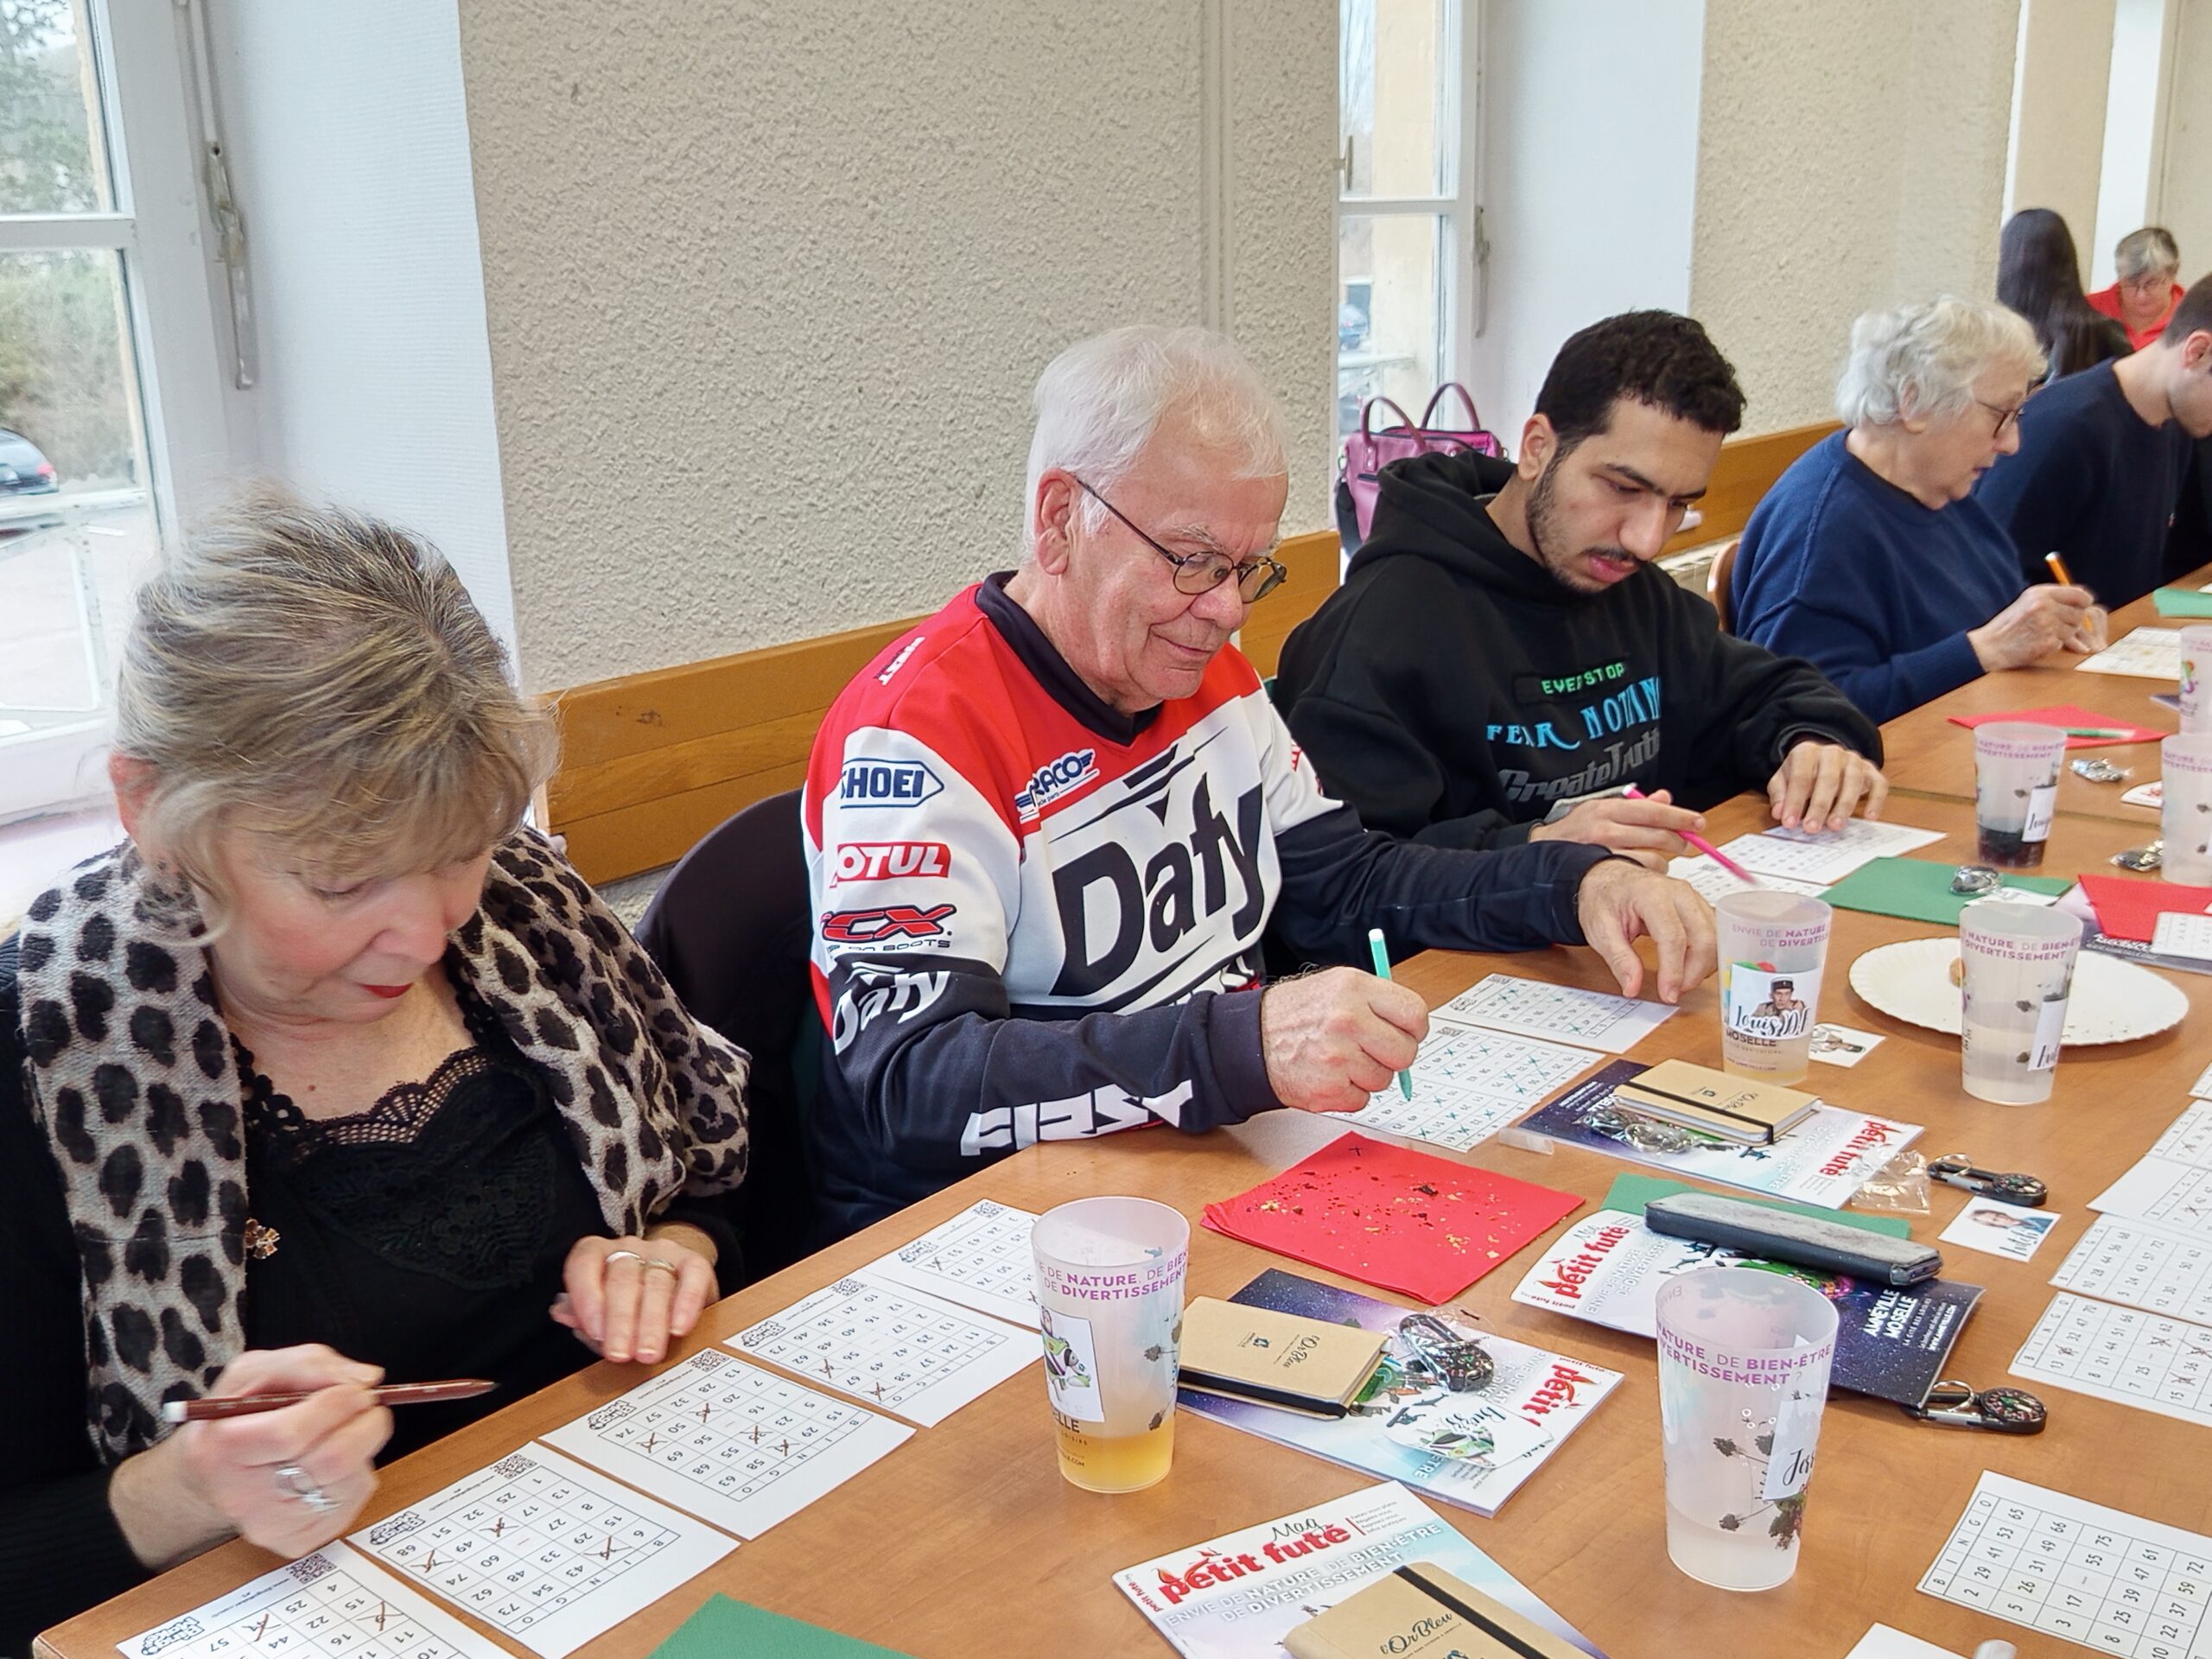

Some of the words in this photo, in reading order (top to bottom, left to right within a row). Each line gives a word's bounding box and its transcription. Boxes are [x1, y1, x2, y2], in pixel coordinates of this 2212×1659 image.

[1049, 771, 1264, 996] Dafy
[1732, 923, 1762, 937] ENVIE
[1766, 929, 1782, 938] DE
[1785, 923, 1826, 938] NATURE
[1760, 938, 1774, 948] DE
[1967, 931, 2014, 950] NATURE
[2022, 941, 2037, 950] DE
[1554, 1254, 1603, 1299] petit
[1585, 1224, 1630, 1254] futé
[1047, 1267, 1063, 1281] DE
[1147, 1265, 1163, 1280] DE
[1044, 1277, 1058, 1293] DE
[1061, 1265, 1186, 1300] DIVERTISSEMENT
[1586, 1286, 1611, 1314] ENVIE
[1613, 1249, 1641, 1283] NATURE
[1616, 1283, 1629, 1297] DE
[1862, 1288, 1900, 1338] AMNÉVILLE
[1883, 1295, 1918, 1339] MOSELLE
[1661, 1340, 1791, 1385] VERTISSEMENT
[1717, 1353, 1740, 1368] DE
[1746, 1343, 1832, 1370] BIEN-ÊTRE
[724, 1369, 741, 1378] 13
[698, 1382, 716, 1393] 28
[1493, 1380, 1518, 1405] NAT
[1522, 1364, 1580, 1415] petit
[670, 1397, 690, 1408] 32
[748, 1405, 765, 1414] 16
[826, 1411, 842, 1421] 15
[645, 1412, 662, 1423] 57
[615, 1427, 635, 1439] 74
[801, 1427, 818, 1437] 29
[694, 1434, 713, 1446] 56
[666, 1451, 683, 1462] 69
[746, 1459, 765, 1470] 58
[718, 1476, 736, 1487] 63
[496, 1492, 517, 1504] 25
[551, 1489, 570, 1499] 13
[462, 1509, 485, 1521] 32
[523, 1506, 538, 1517] 17
[549, 1518, 567, 1531] 27
[604, 1516, 622, 1527] 15
[431, 1527, 452, 1539] 51
[1270, 1517, 1326, 1542] Mag
[574, 1532, 594, 1544] 29
[397, 1544, 416, 1556] 68
[455, 1541, 473, 1553] 49
[1963, 1588, 1980, 1598] 2
[1974, 1567, 1992, 1580] 29
[1986, 1546, 2003, 1559] 41
[1996, 1527, 2014, 1540] 53
[2007, 1508, 2024, 1520] 65
[480, 1554, 500, 1567] 60
[540, 1550, 561, 1563] 33
[1158, 1553, 1264, 1605] petit
[1262, 1522, 1351, 1565] futé
[2007, 1603, 2023, 1611] 5
[2018, 1580, 2036, 1594] 26
[2028, 1560, 2045, 1573] 31
[2040, 1540, 2056, 1552] 49
[2050, 1522, 2067, 1533] 66
[2186, 1561, 2204, 1573] 72
[506, 1570, 524, 1582] 48
[565, 1565, 583, 1577] 43
[1166, 1602, 1217, 1627] ENVIE
[1221, 1592, 1244, 1608] DE
[1246, 1567, 1319, 1601] NATURE
[1327, 1558, 1348, 1573] DE
[1351, 1522, 1443, 1564] BIEN-ÊTRE
[2066, 1594, 2082, 1607] 17
[2085, 1554, 2103, 1567] 55
[2094, 1535, 2113, 1548] 75
[445, 1573, 468, 1586] 74
[326, 1582, 338, 1593] 4
[531, 1584, 554, 1598] 54
[1223, 1607, 1246, 1623] DE
[1248, 1550, 1403, 1615] DIVERTISSEMENT
[2177, 1582, 2196, 1595] 59
[471, 1589, 493, 1601] 62
[2104, 1635, 2121, 1643] 8
[2113, 1610, 2132, 1624] 25
[2123, 1589, 2140, 1603] 39
[2134, 1567, 2150, 1580] 47
[2142, 1549, 2158, 1560] 61
[285, 1599, 307, 1614] 25
[345, 1597, 365, 1612] 15
[498, 1603, 520, 1616] 73
[2169, 1602, 2187, 1618] 37
[308, 1615, 329, 1630] 22
[1380, 1612, 1453, 1656] l'OrBleu
[2159, 1624, 2178, 1639] 22
[208, 1637, 230, 1652] 57
[268, 1636, 289, 1650] 44
[2152, 1647, 2171, 1659] 10
